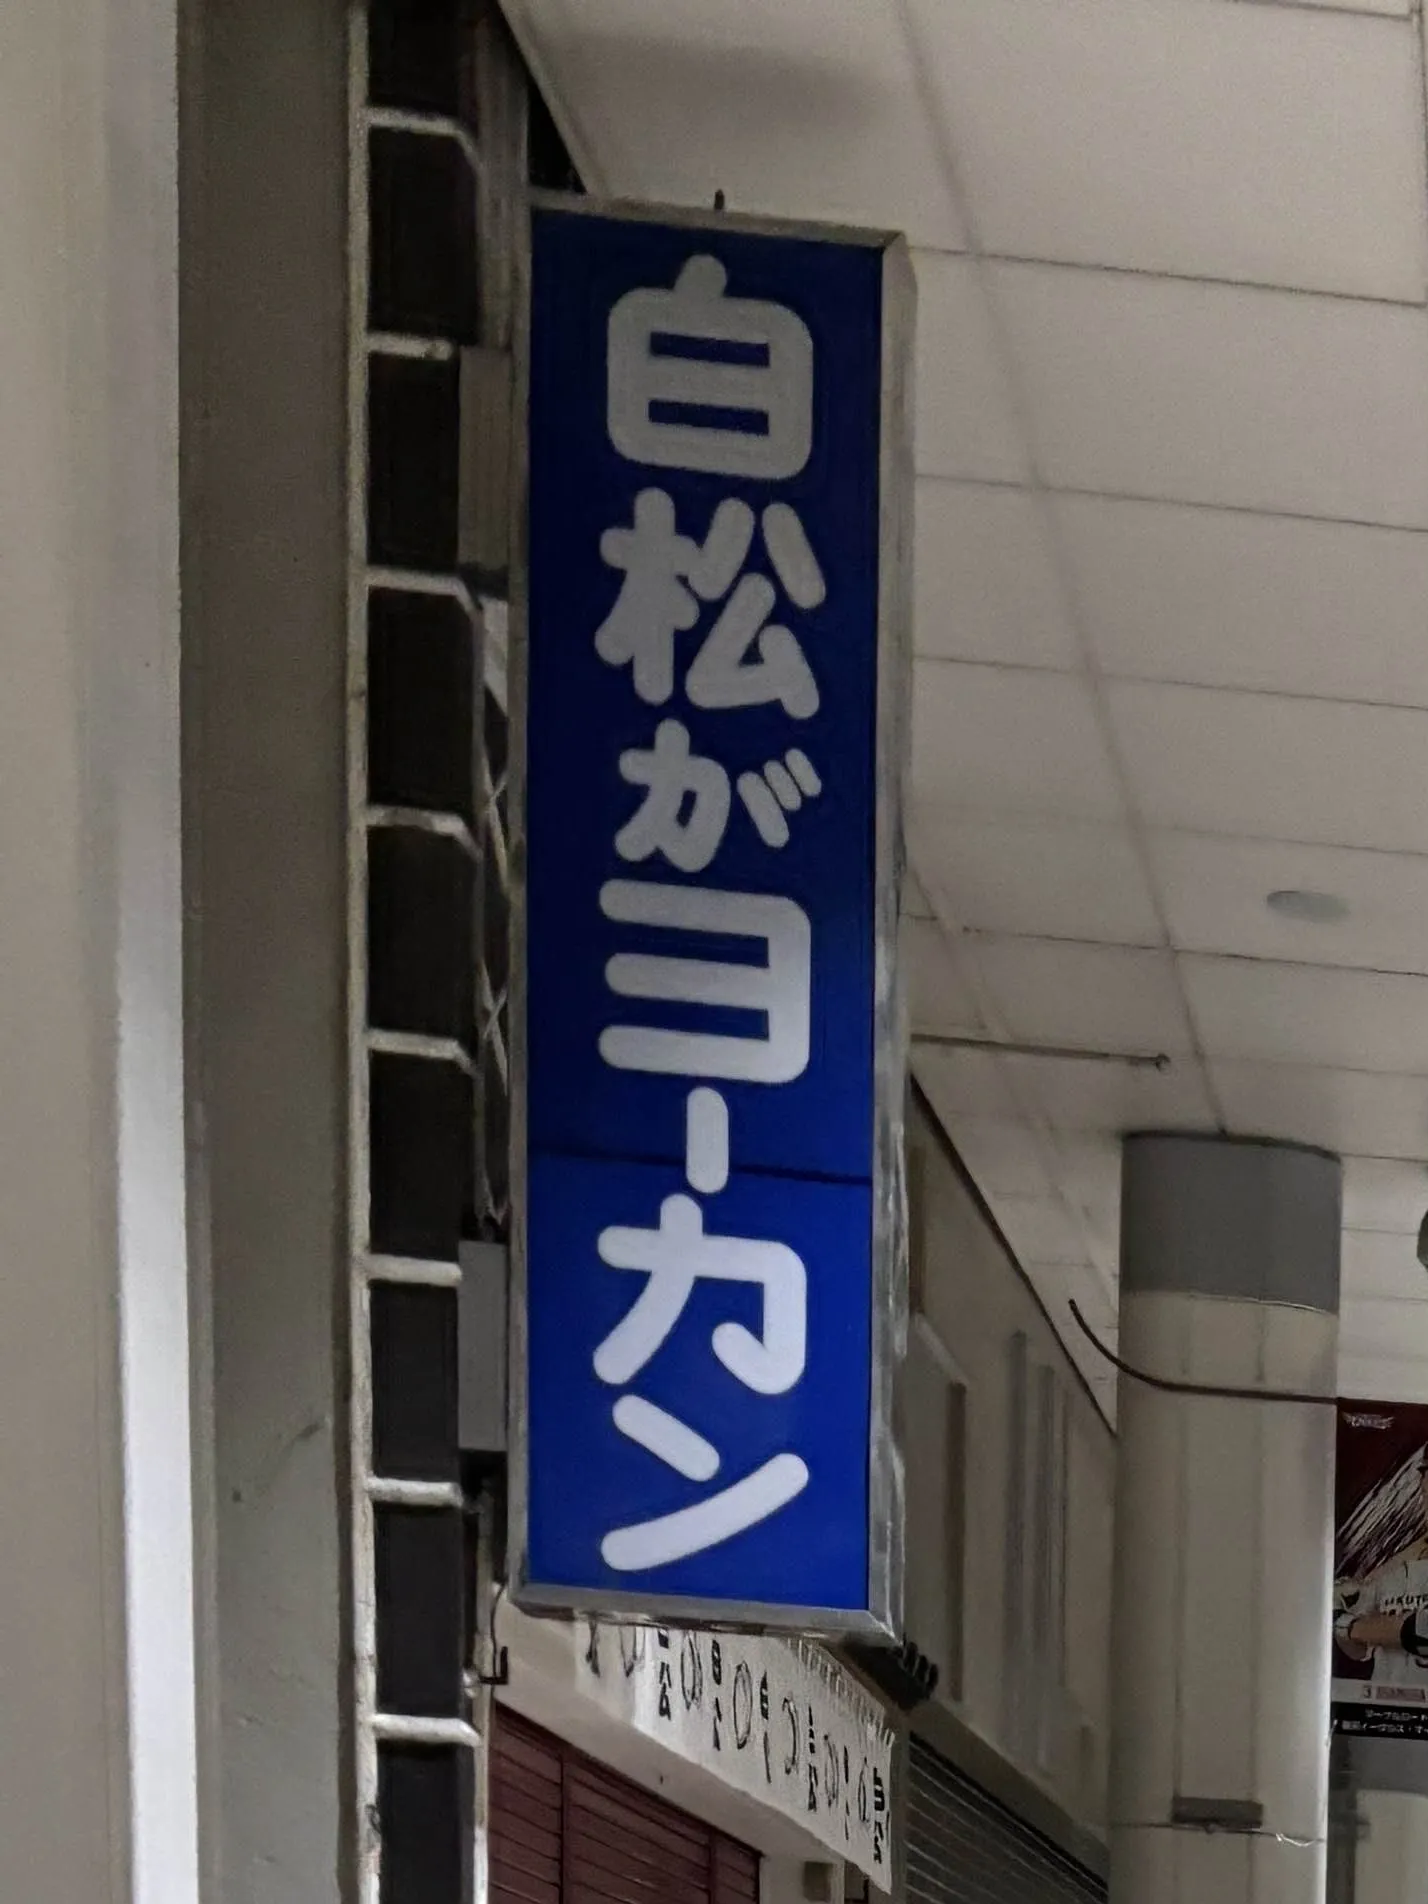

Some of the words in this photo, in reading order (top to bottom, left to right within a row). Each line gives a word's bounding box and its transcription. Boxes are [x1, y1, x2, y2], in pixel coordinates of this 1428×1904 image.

[594, 253, 823, 1572] 白松がヨーカン
